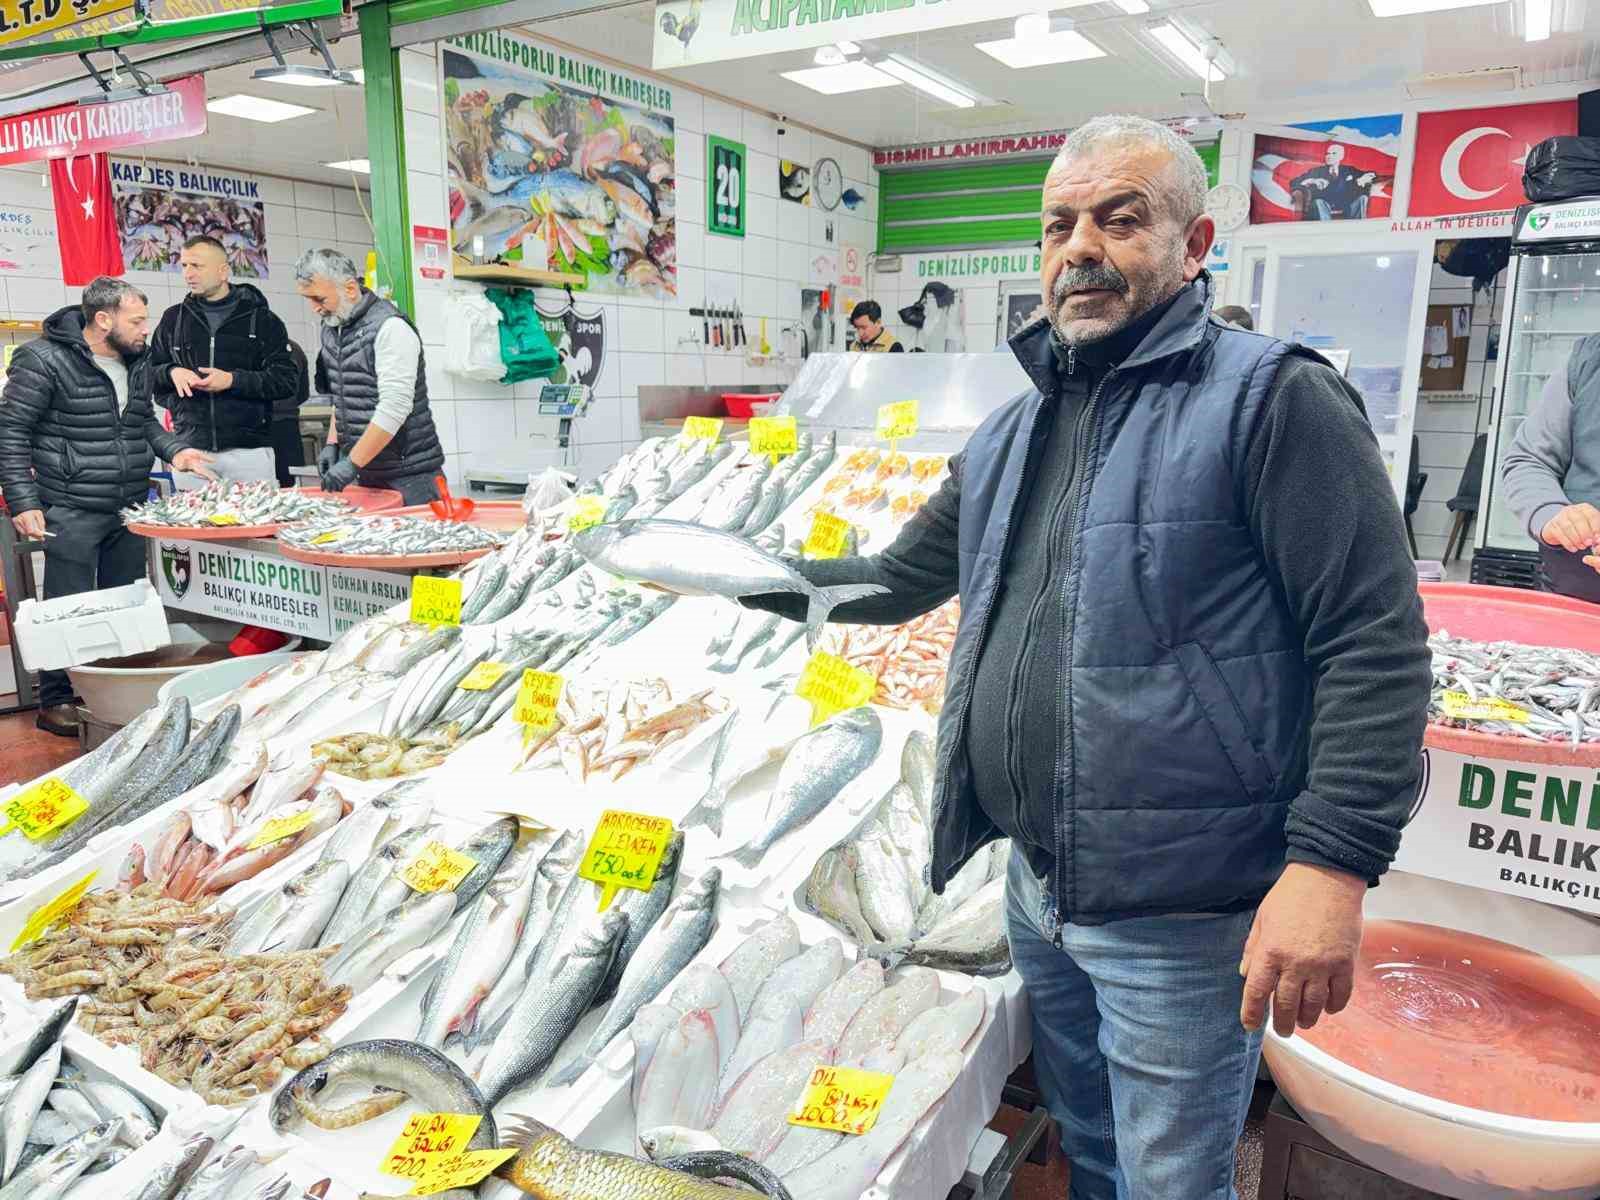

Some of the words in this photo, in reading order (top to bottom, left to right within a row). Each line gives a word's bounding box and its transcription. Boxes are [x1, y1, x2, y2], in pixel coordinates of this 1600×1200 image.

[559, 55, 607, 93] BALIKÇI
[610, 73, 672, 112] KARDEŞLER
[21, 110, 82, 150] BALIKÇI
[85, 91, 185, 140] KARDEŞLER
[179, 172, 259, 199] BALIKÇILIK
[715, 163, 740, 209] 20
[1391, 221, 1432, 233] ALLAH
[198, 550, 322, 597] DENİZLİSPORLU
[332, 572, 369, 594] GÖKHAN
[371, 580, 408, 600] ARSLAN
[204, 581, 247, 607] BALIKÇI
[250, 589, 319, 619] KARDEŞLER
[333, 596, 364, 616] KEMAL
[1468, 822, 1600, 873] BALIK
